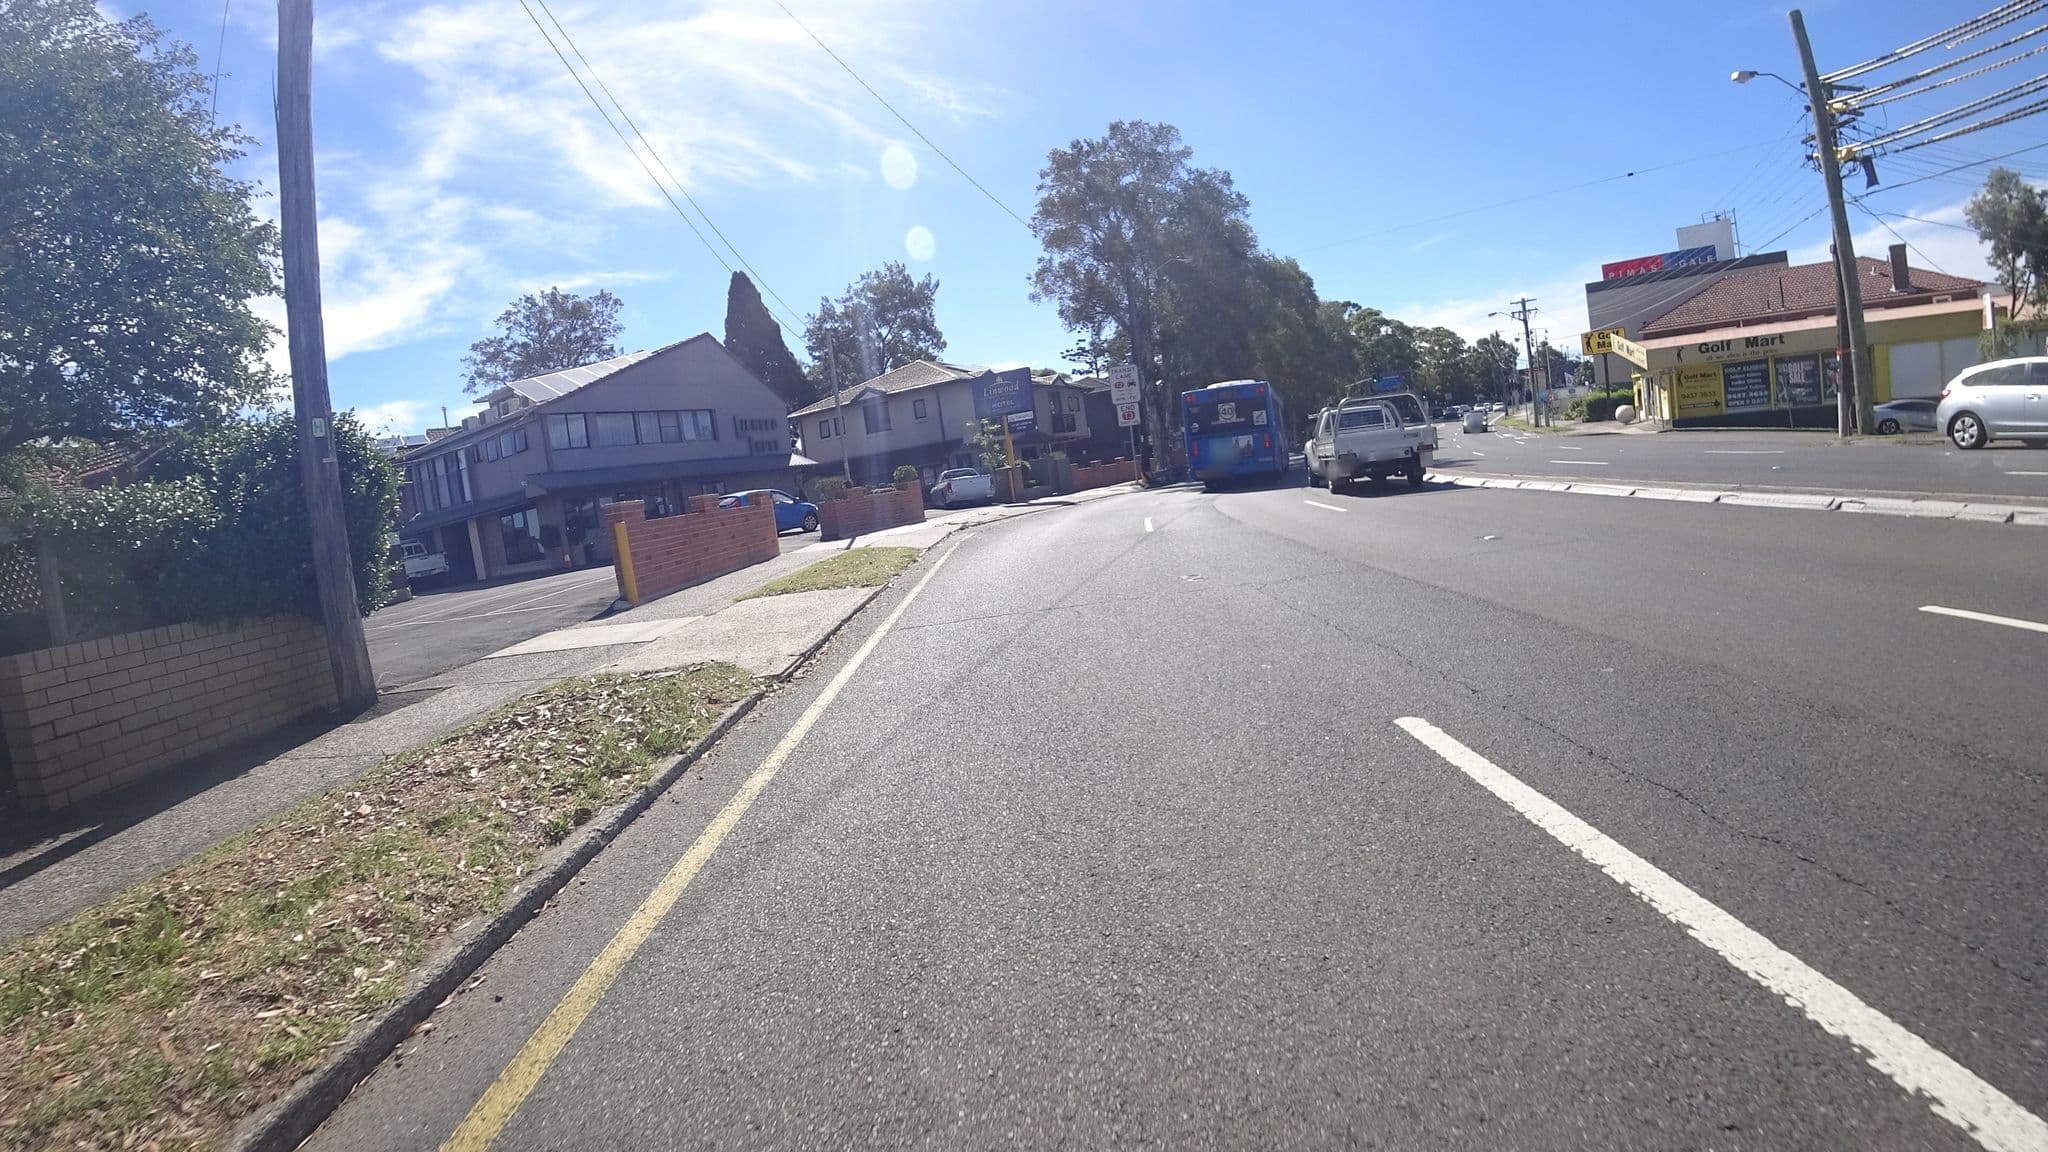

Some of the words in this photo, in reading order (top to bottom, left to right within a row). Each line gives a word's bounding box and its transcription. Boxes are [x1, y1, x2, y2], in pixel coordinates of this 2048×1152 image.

[1597, 340, 1611, 349] Ma
[1698, 340, 1732, 354] Golf
[1745, 333, 1785, 349] Mart
[1120, 404, 1135, 412] END
[1222, 407, 1233, 415] 40
